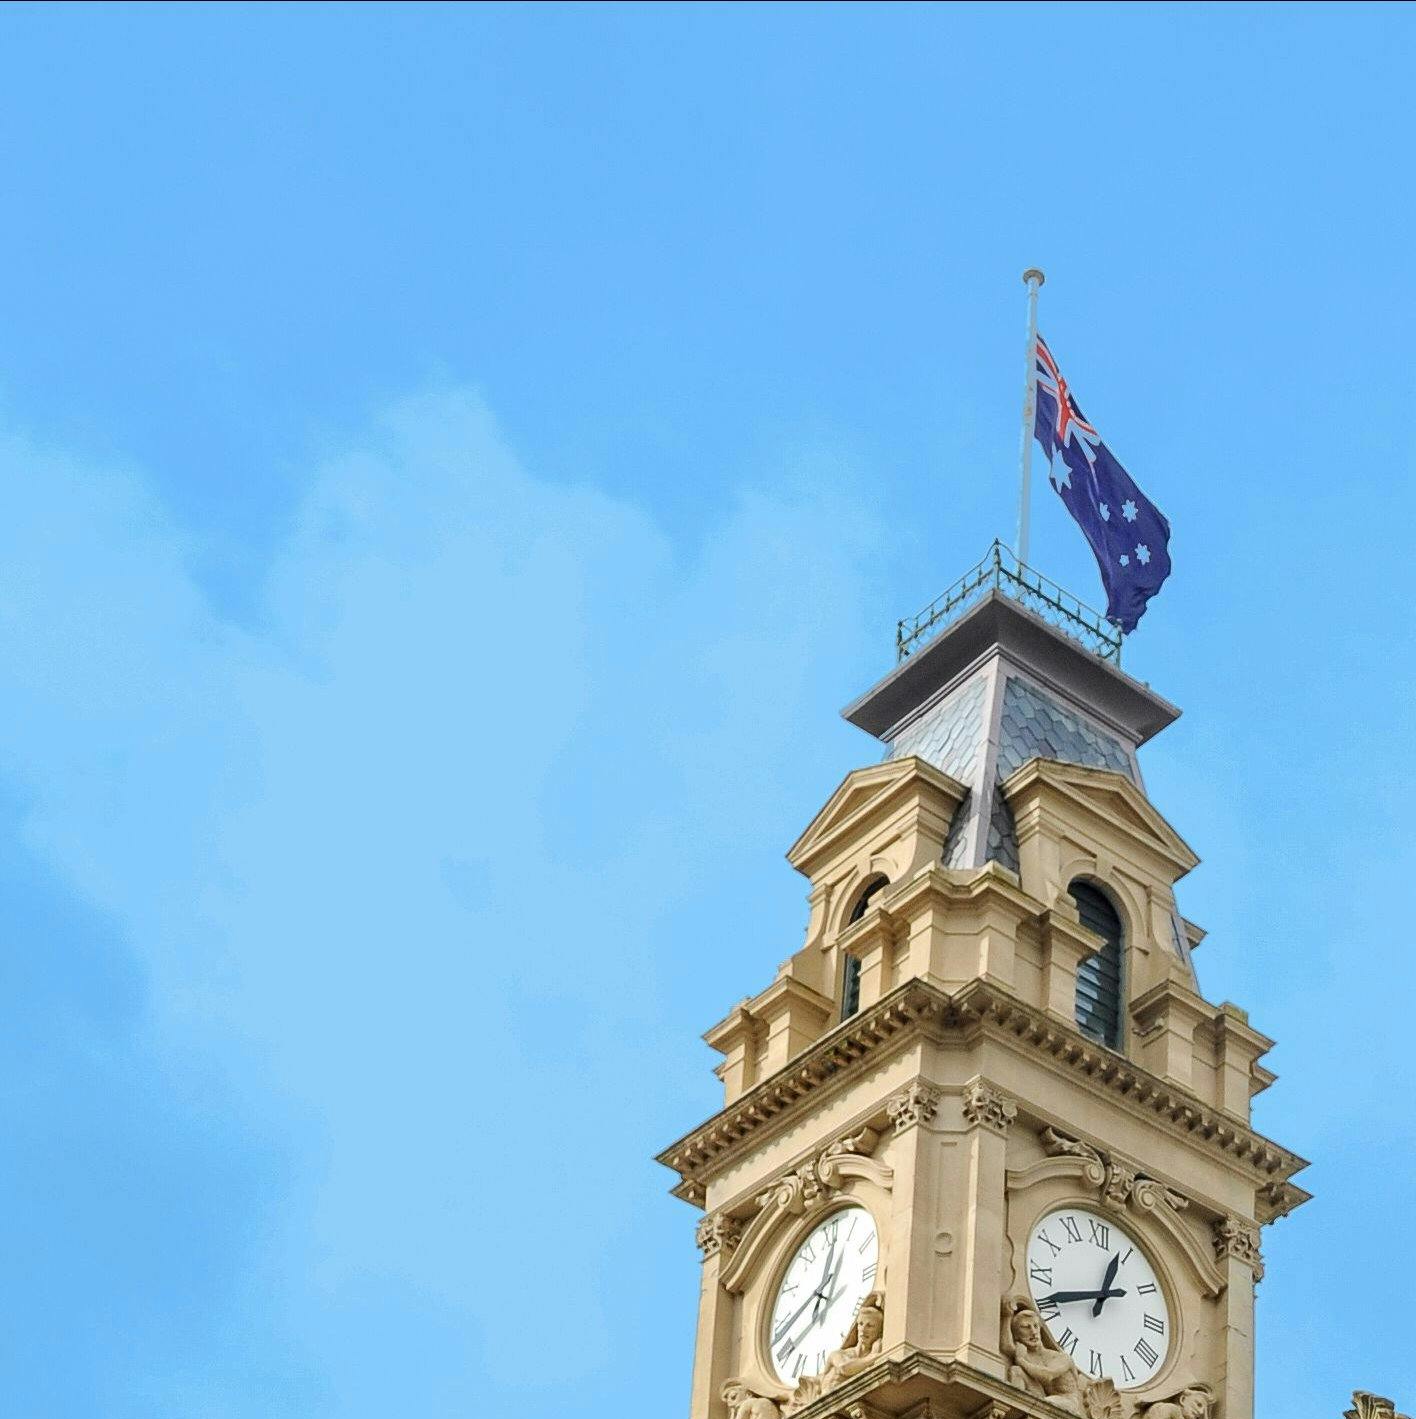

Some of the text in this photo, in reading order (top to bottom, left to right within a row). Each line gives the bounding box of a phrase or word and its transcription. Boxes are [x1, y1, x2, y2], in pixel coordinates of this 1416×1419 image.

[1037, 1229, 1062, 1257] X
[1059, 1217, 1083, 1243] XI
[1088, 1219, 1110, 1251] XII
[1121, 1248, 1134, 1264] I
[1030, 1259, 1052, 1287] IX
[1136, 1283, 1157, 1295] II
[1143, 1313, 1164, 1335] III
[1089, 1350, 1103, 1378] VI
[1134, 1337, 1159, 1369] IIII
[1120, 1355, 1136, 1381] V
